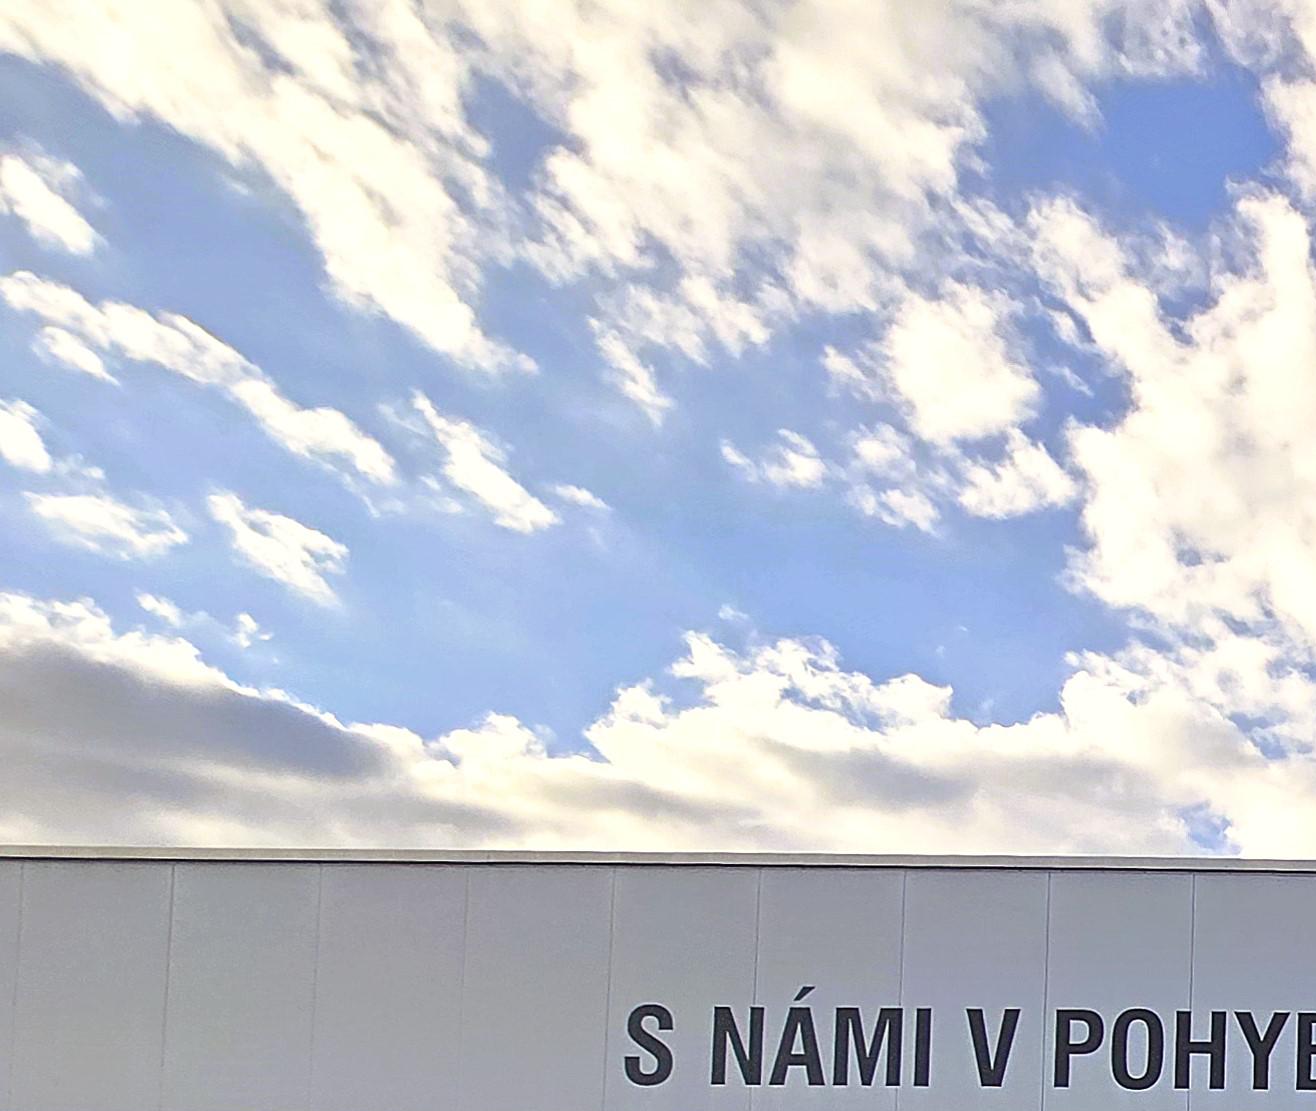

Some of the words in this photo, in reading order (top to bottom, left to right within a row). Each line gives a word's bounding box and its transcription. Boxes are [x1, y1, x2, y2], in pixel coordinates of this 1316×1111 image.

[623, 1003, 674, 1086] S
[710, 985, 932, 1087] NÁMI
[966, 1008, 1021, 1087] V
